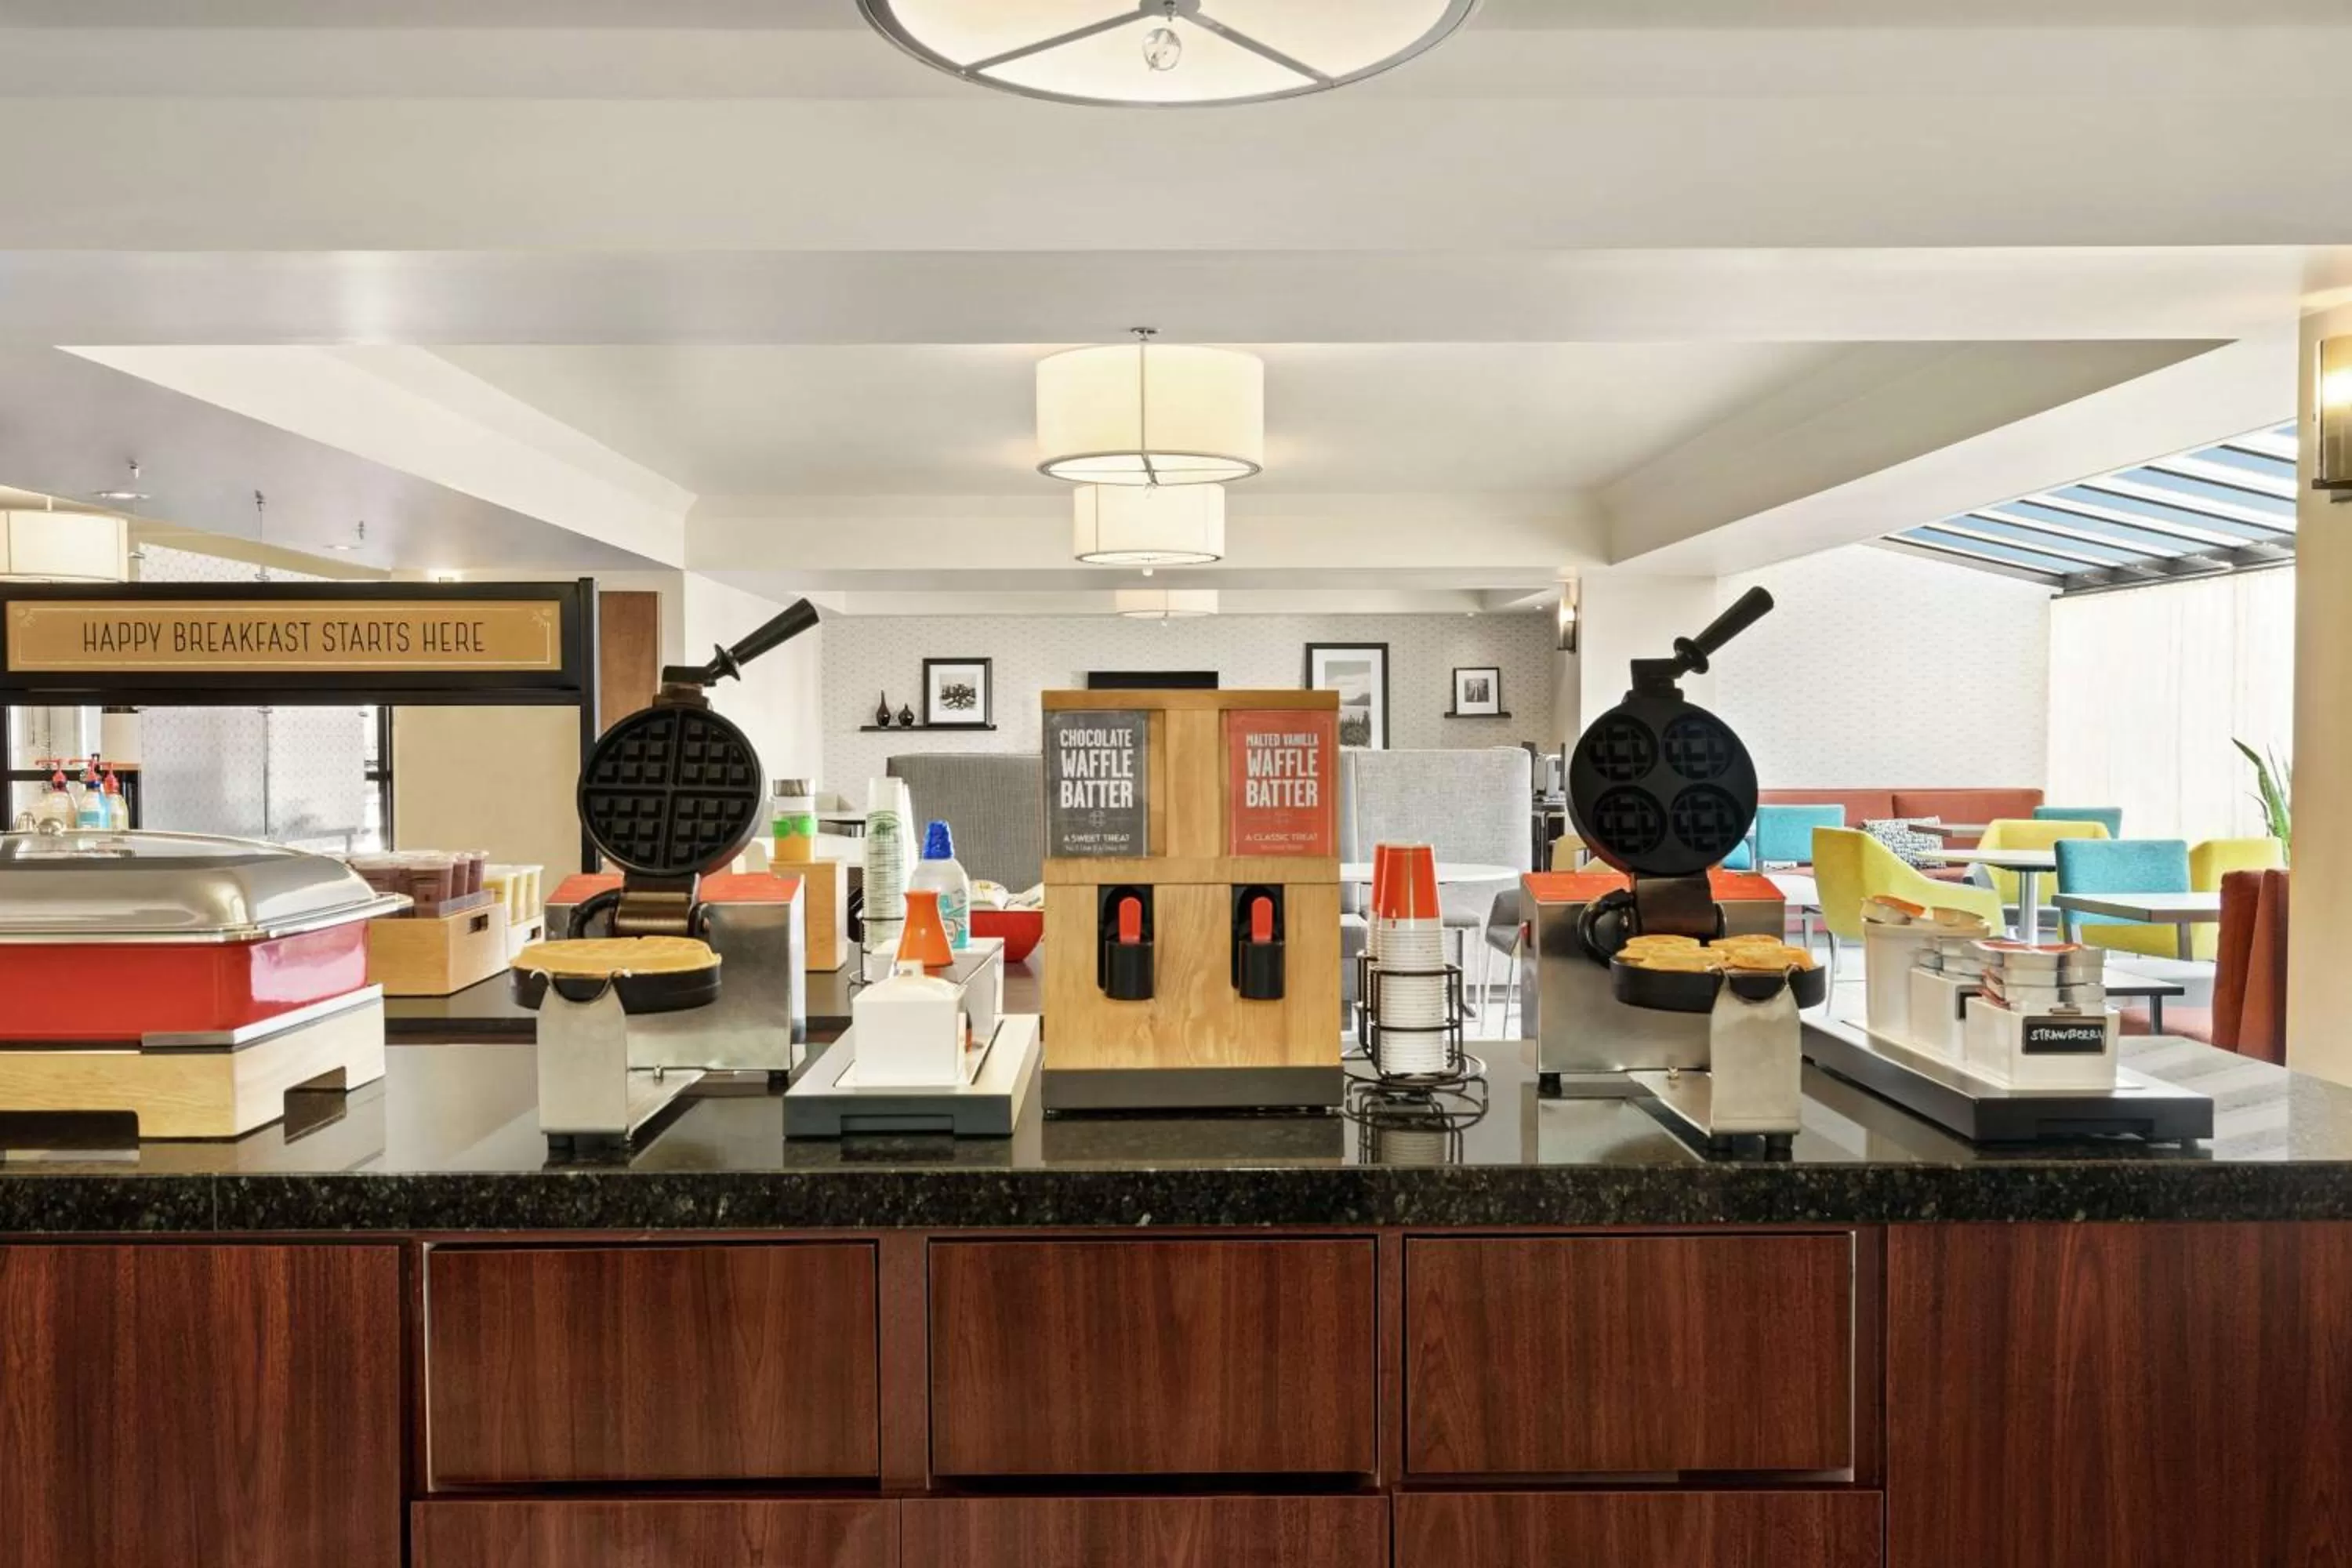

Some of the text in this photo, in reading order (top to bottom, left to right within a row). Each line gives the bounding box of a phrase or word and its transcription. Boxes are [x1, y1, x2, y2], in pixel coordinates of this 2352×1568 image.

[82, 621, 486, 653] HAPPY BREAKFAST STARTS HERE
[1059, 728, 1133, 747] CHOCOLATE
[1245, 733, 1279, 747] MALTED
[1061, 749, 1134, 779] WAFFLE
[1247, 748, 1319, 778] WAFFLE
[1061, 779, 1133, 808] BATTER
[1246, 779, 1318, 808] BATTER
[1062, 833, 1069, 843] A
[2030, 1028, 2105, 1046] STRAWBERRY
